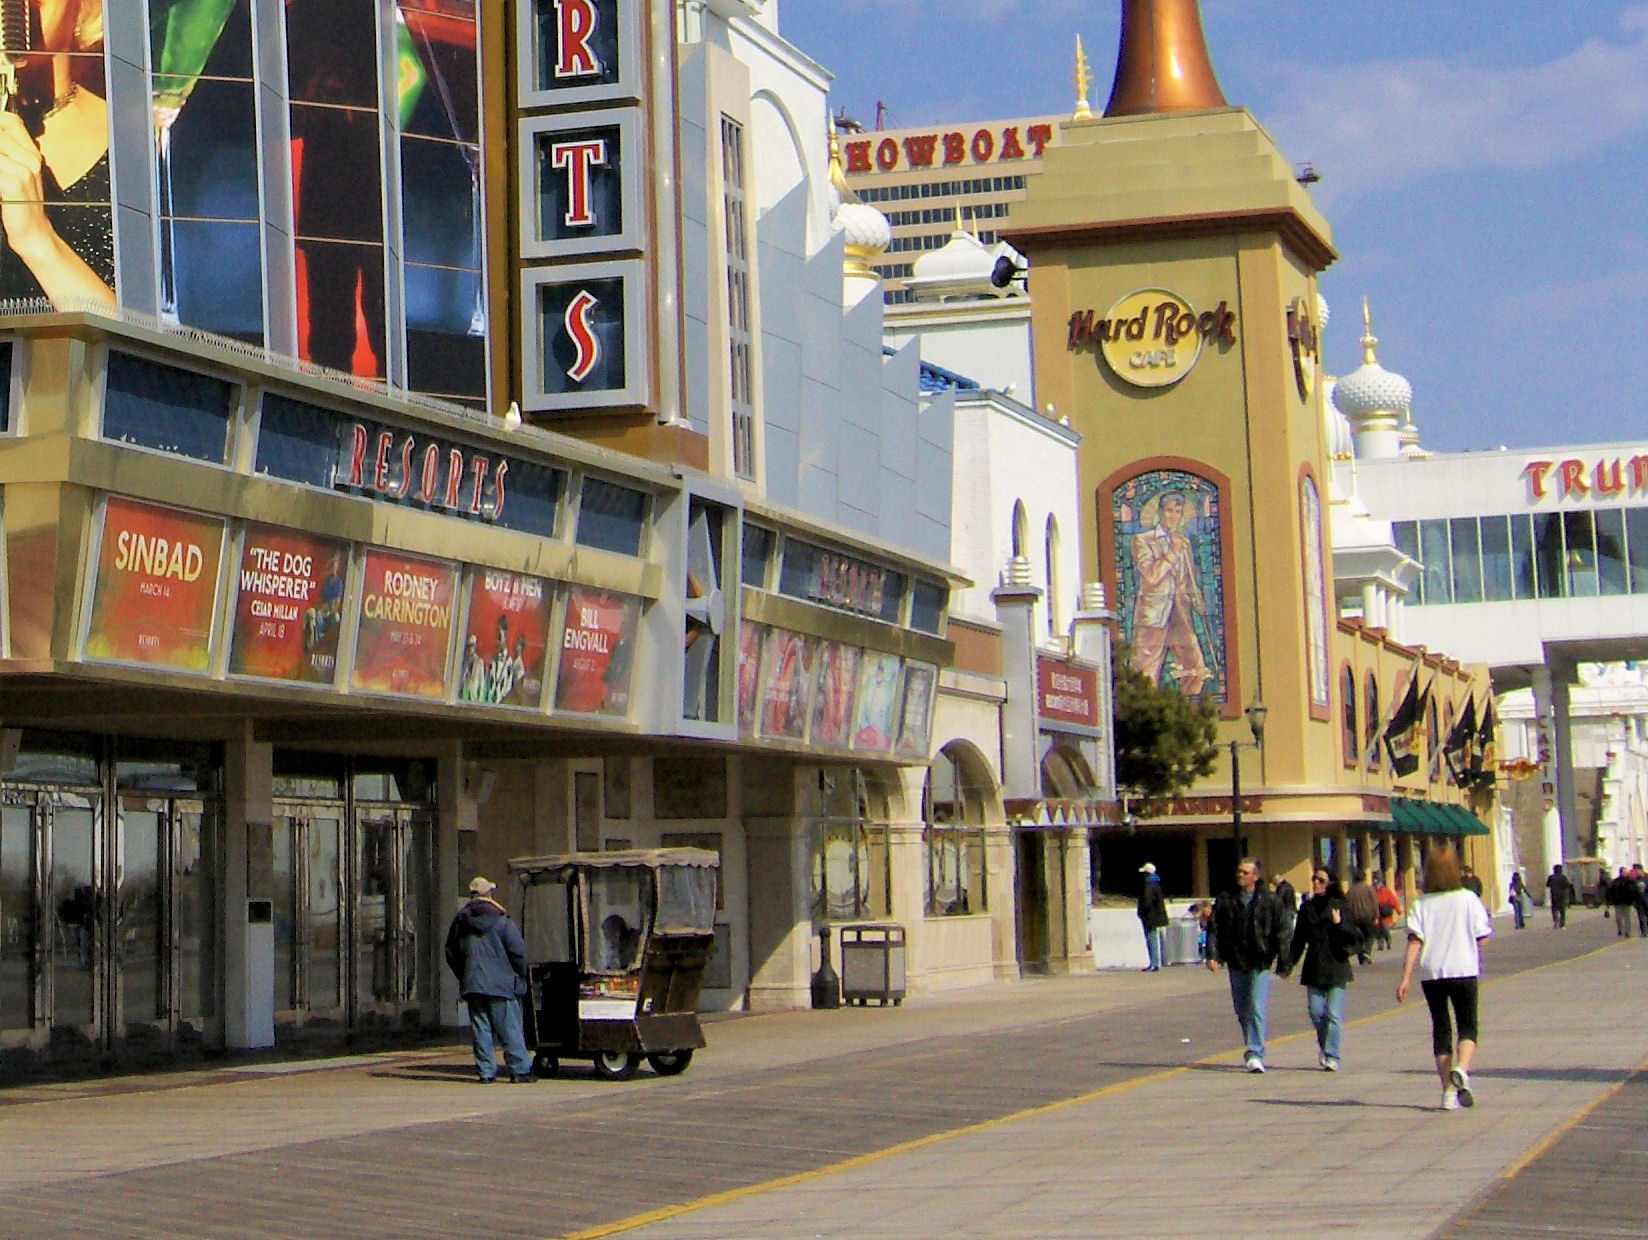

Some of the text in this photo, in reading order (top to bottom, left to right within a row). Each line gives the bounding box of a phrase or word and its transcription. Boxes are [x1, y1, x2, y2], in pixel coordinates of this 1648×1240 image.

[841, 123, 1052, 173] HOWBOAT
[1067, 306, 1149, 351] Hard
[1154, 301, 1236, 346] Rock
[1129, 349, 1177, 368] CAFE
[349, 424, 508, 519] RESORTS
[114, 530, 203, 582] SINBAD
[250, 547, 313, 577] “THE DOG
[241, 569, 317, 601] WHISPERER”
[384, 570, 438, 600] RODNEY
[364, 594, 450, 629] CARRINGTON
[580, 608, 599, 629] BILL
[564, 627, 609, 653] ENGVALL
